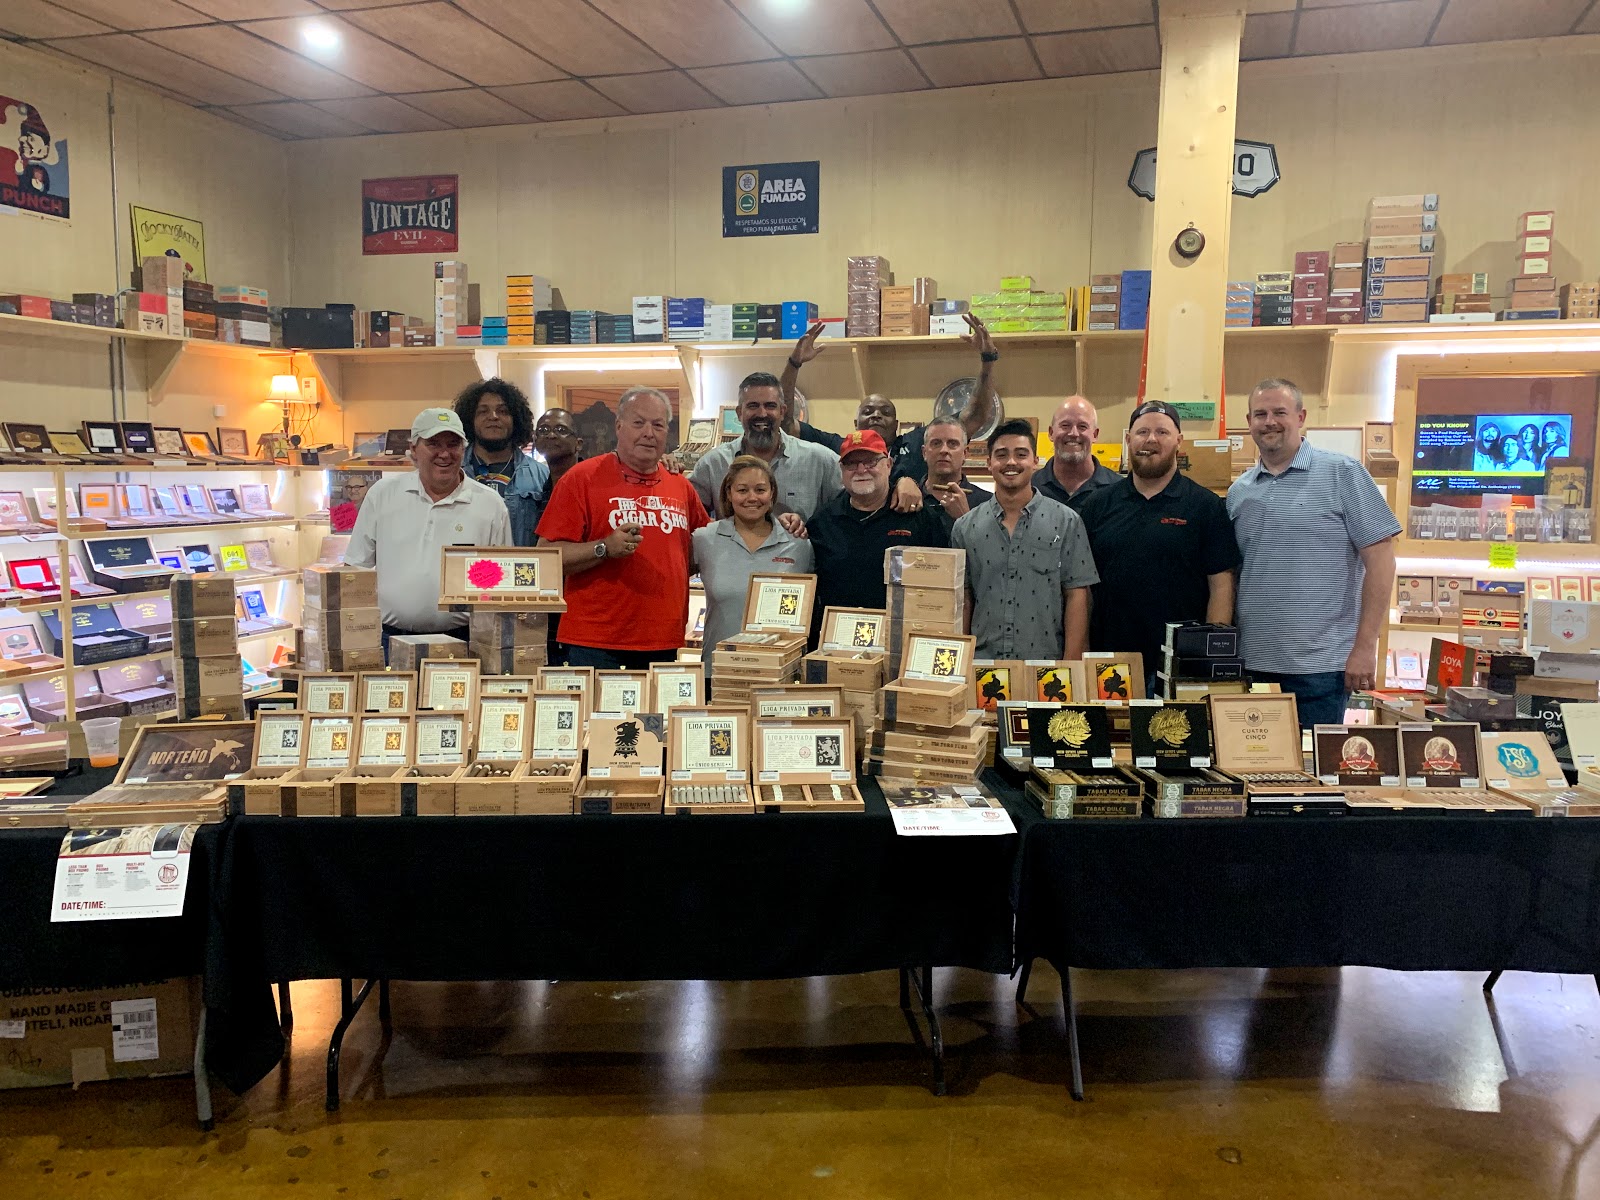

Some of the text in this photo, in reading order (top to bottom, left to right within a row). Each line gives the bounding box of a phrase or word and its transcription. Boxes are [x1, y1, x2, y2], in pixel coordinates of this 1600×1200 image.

[761, 178, 806, 194] AREA
[3, 188, 63, 212] PUNCH
[760, 192, 806, 204] FUMADO
[370, 197, 451, 232] VINTAGE
[394, 231, 426, 240] EVIL
[608, 509, 659, 532] CIGAR
[1554, 616, 1585, 624] JOYA
[1441, 655, 1462, 668] JOYA
[1534, 710, 1562, 720] JOY
[1545, 721, 1564, 729] Black
[148, 748, 209, 765] NORTEÑO
[1501, 746, 1530, 769] FSG
[61, 900, 106, 910] DATE/TIME:
[1, 986, 61, 998] OBACCO
[10, 1005, 50, 1018] HAND
[55, 1002, 96, 1014] MADE
[69, 1014, 112, 1027] NICAR
